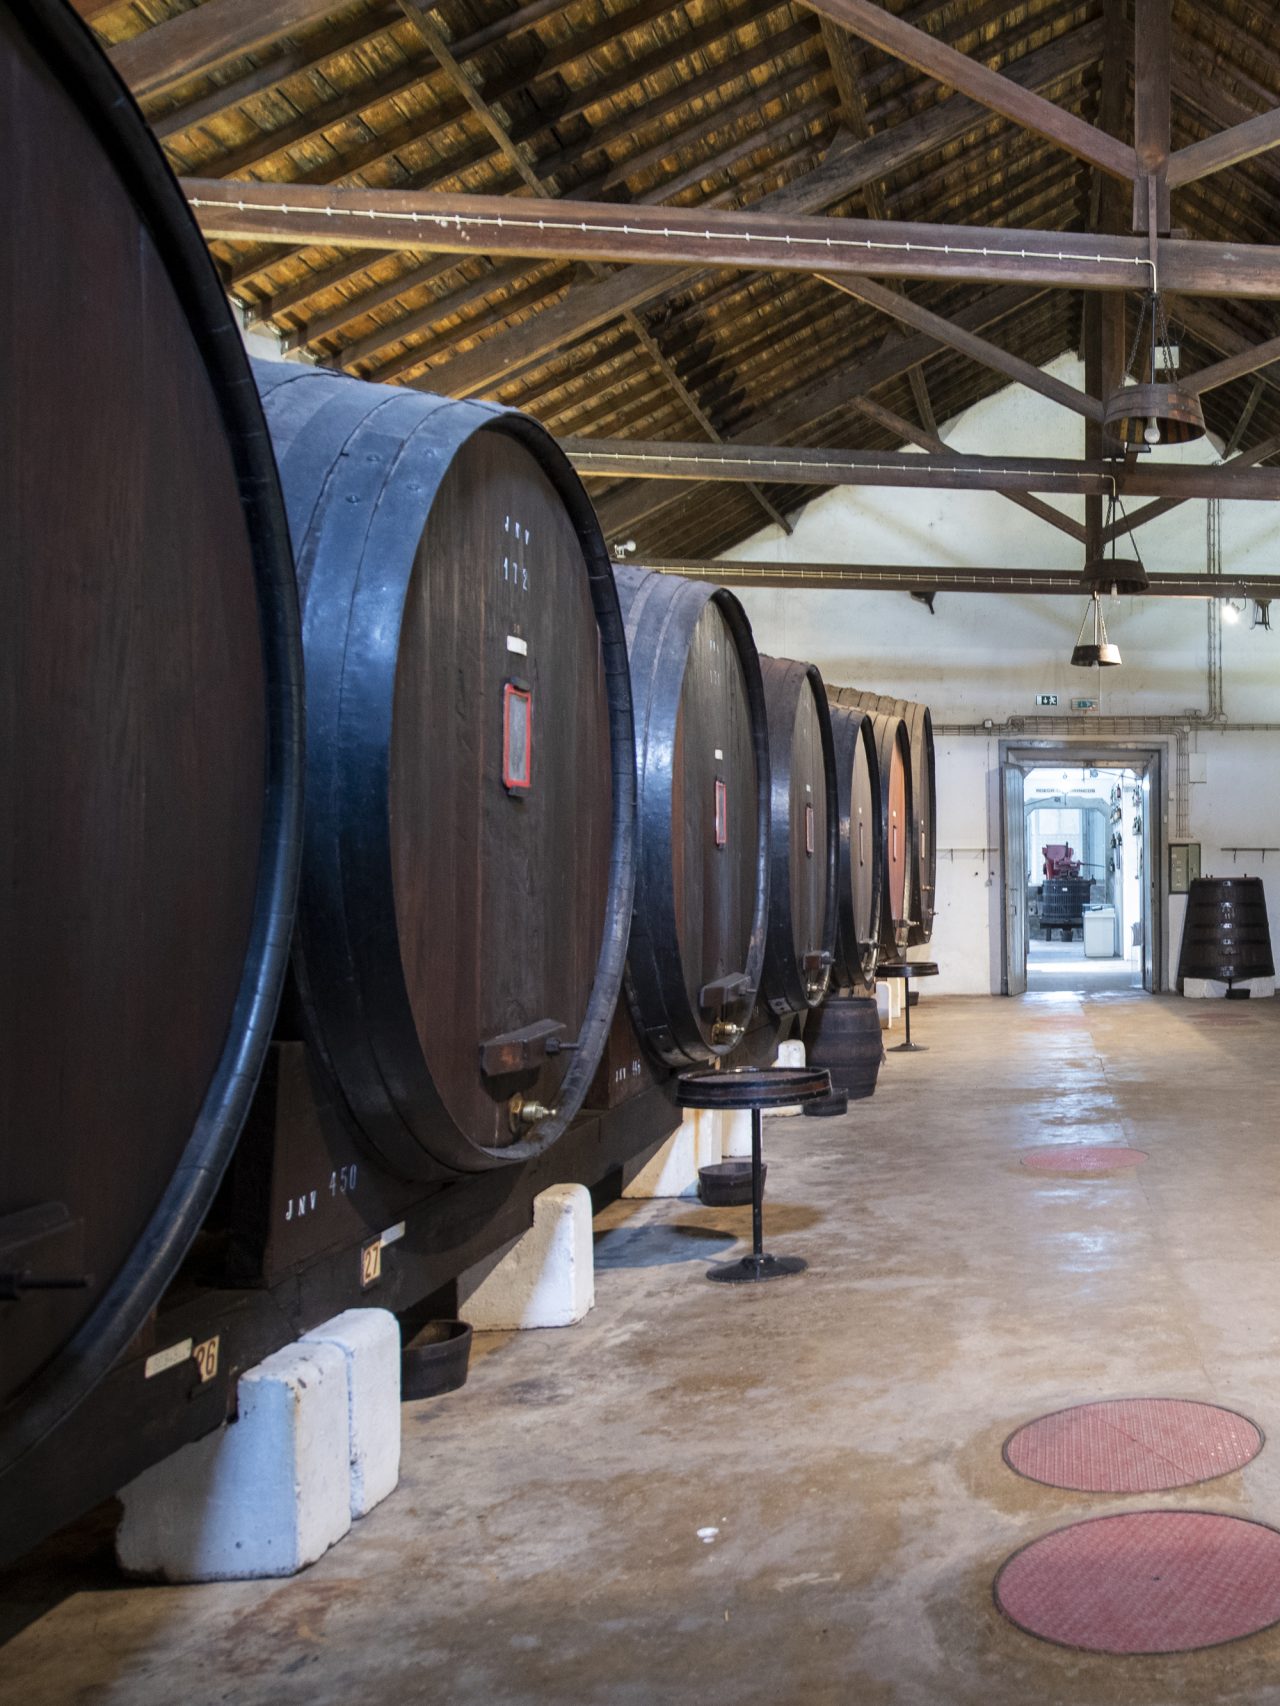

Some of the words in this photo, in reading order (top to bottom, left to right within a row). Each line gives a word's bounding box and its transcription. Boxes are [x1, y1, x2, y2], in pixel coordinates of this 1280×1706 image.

[503, 556, 528, 591] 172
[285, 1190, 317, 1221] JNV
[328, 1163, 357, 1197] 450
[364, 1244, 379, 1279] 27
[196, 1340, 216, 1376] 26
